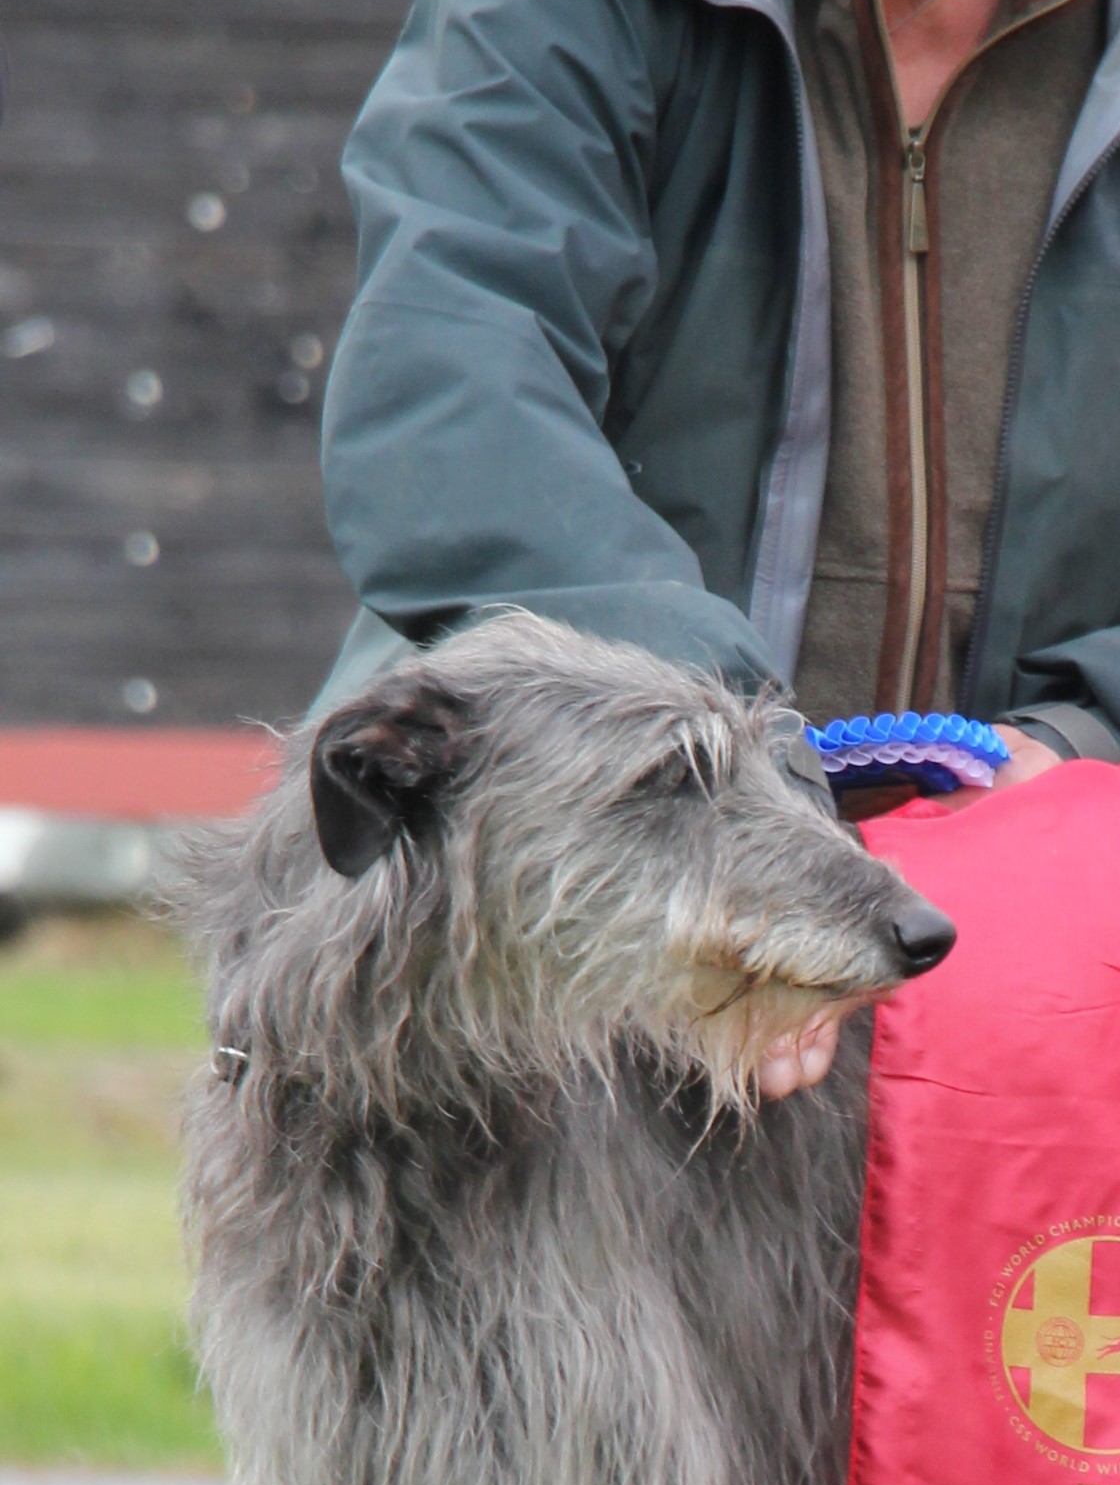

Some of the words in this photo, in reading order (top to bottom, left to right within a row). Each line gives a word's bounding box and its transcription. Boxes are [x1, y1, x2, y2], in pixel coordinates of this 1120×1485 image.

[988, 1280, 1006, 1307] FCI
[1001, 1233, 1046, 1278] WORLD
[1009, 1416, 1032, 1442] CSS
[1034, 1440, 1090, 1473] WORLD
